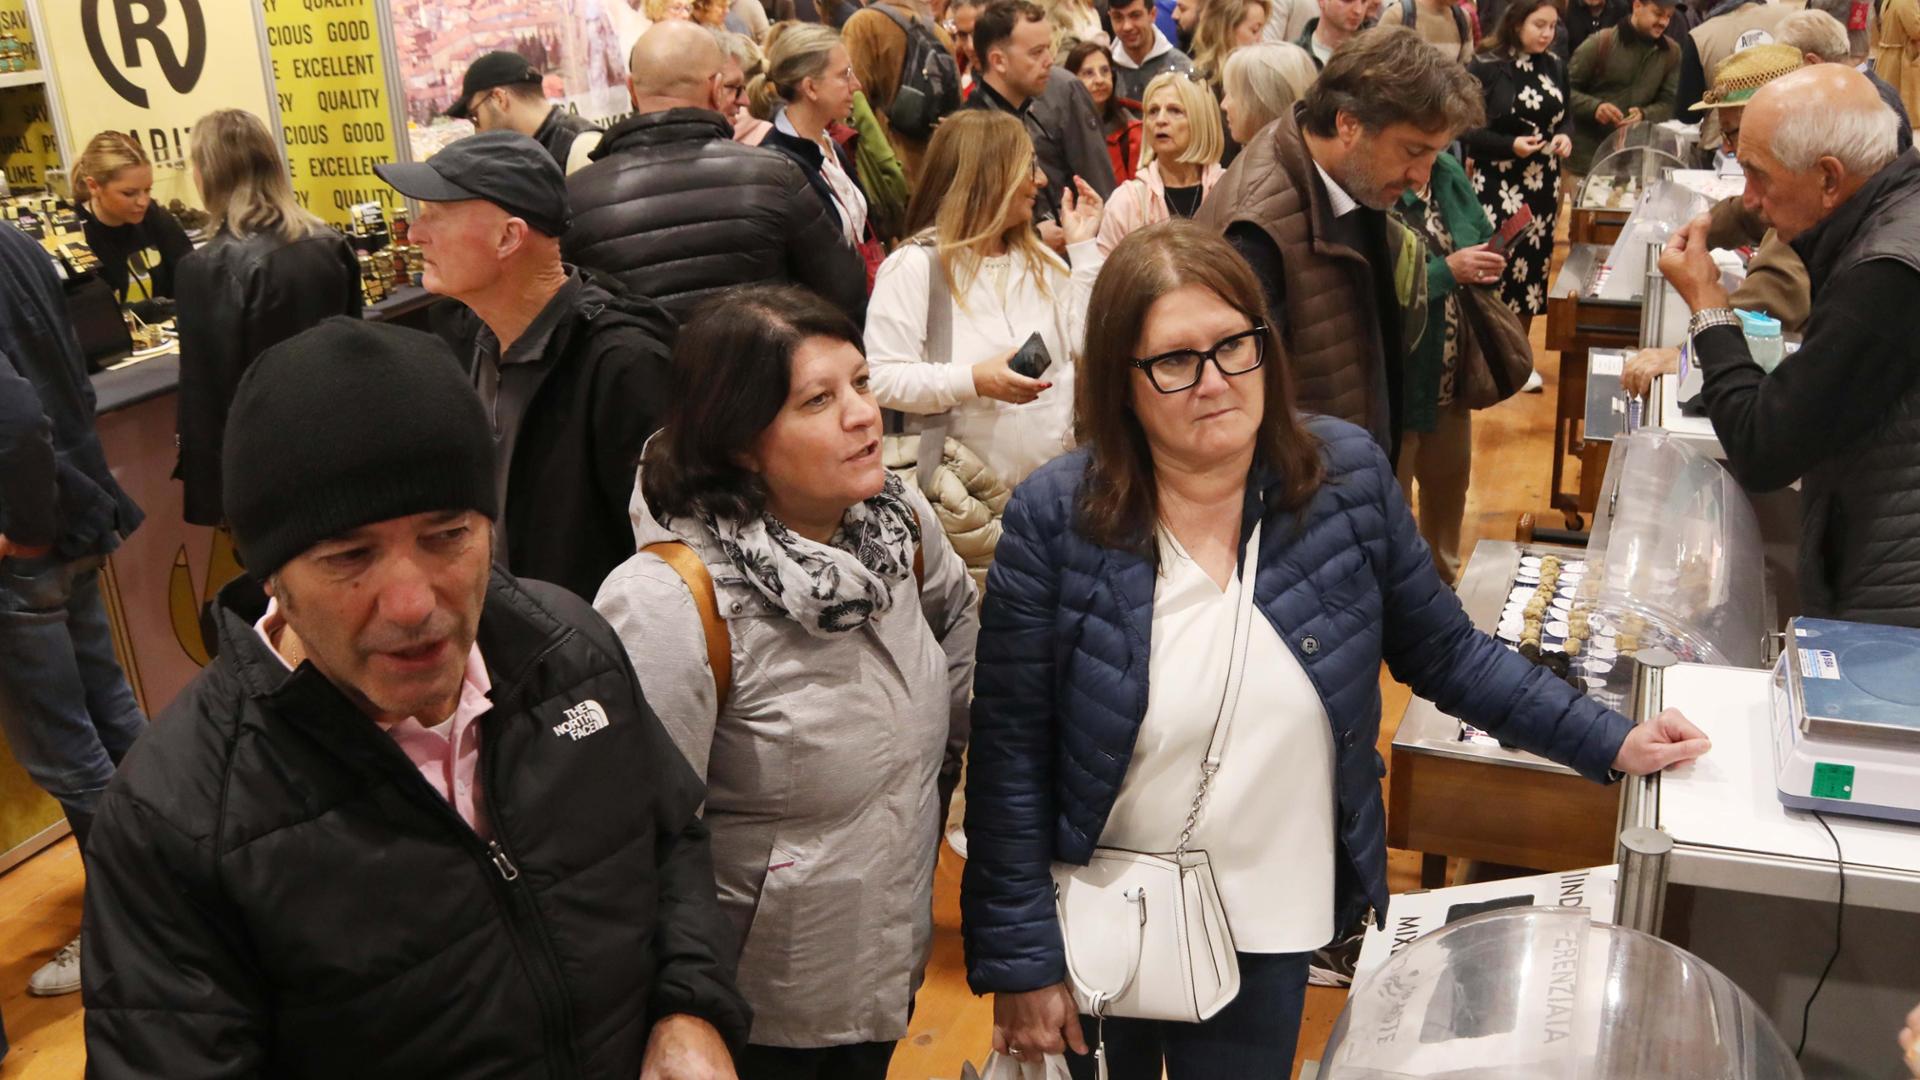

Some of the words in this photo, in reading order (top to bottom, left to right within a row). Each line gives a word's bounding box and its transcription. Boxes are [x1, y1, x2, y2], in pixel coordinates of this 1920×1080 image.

[266, 24, 313, 46] CIOUS
[327, 20, 370, 42] GOOD
[293, 54, 375, 78] EXCELLENT
[317, 88, 380, 113] QUALITY
[283, 124, 329, 145] CIOUS
[342, 122, 385, 143] GOOD
[563, 702, 588, 720] THE
[552, 711, 594, 737] NORTH
[569, 721, 597, 741] FACE
